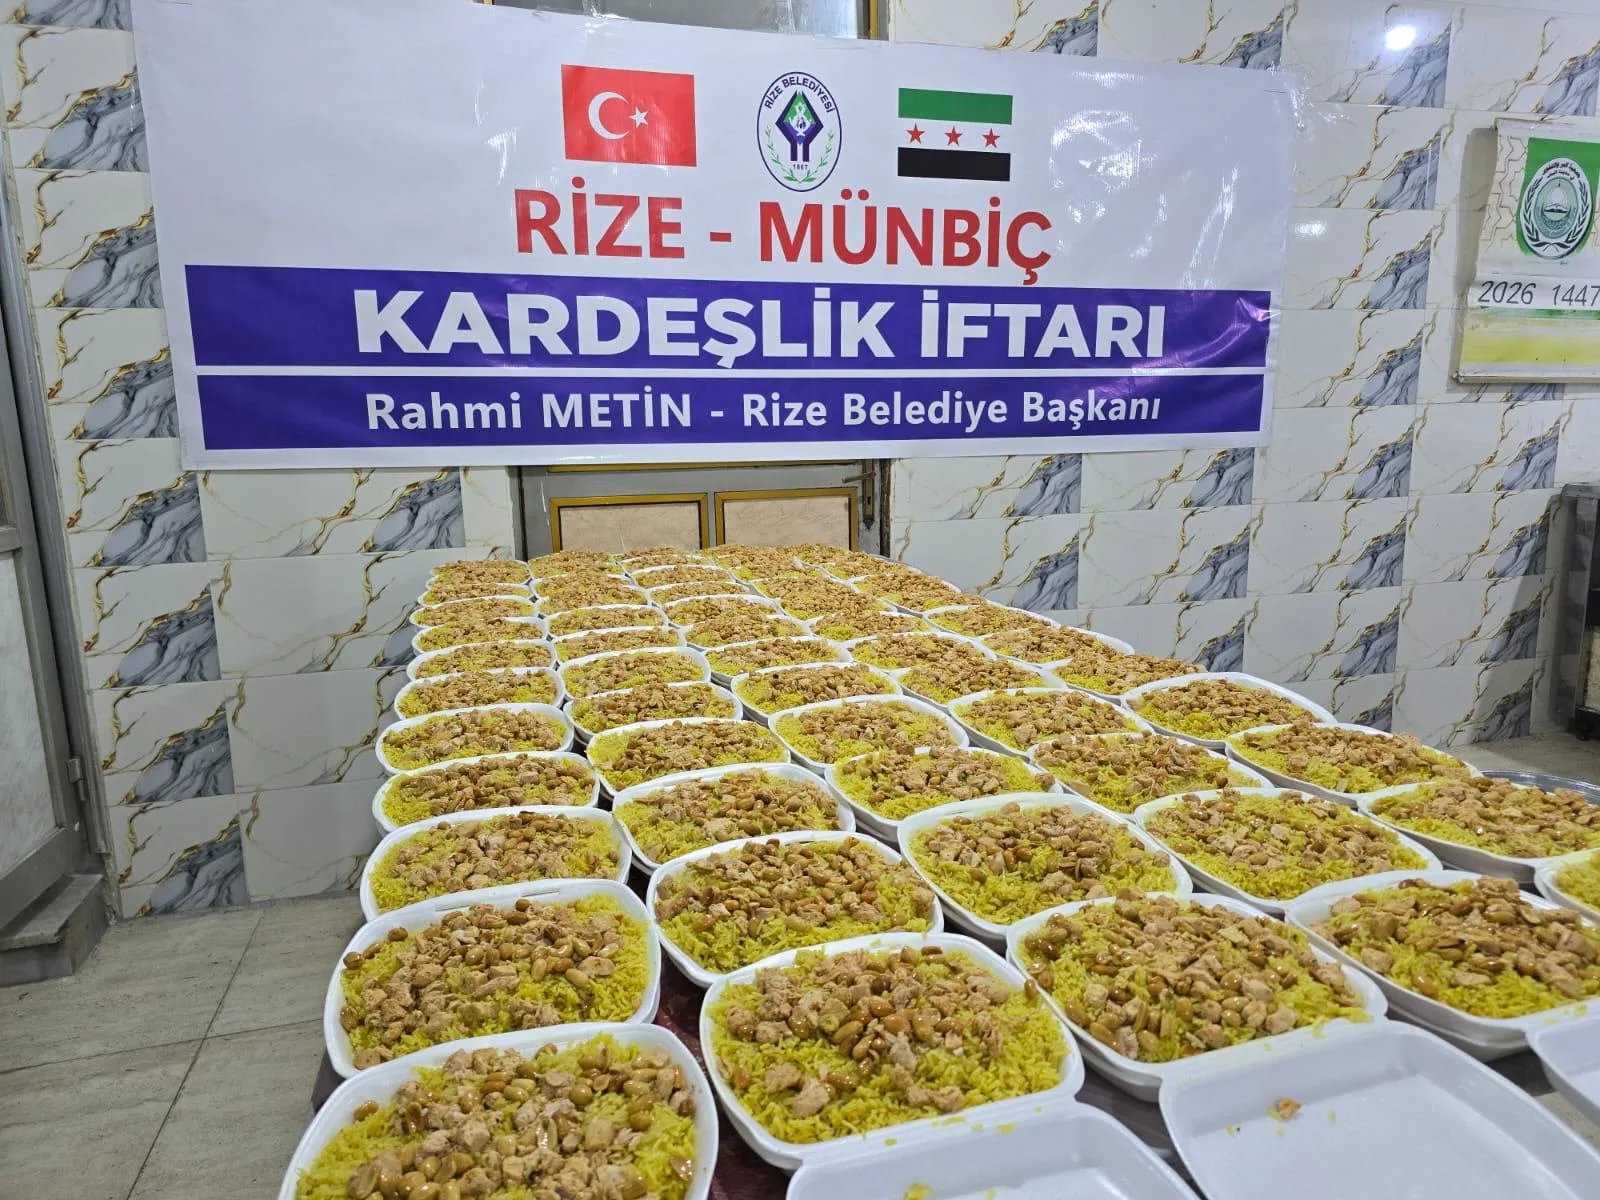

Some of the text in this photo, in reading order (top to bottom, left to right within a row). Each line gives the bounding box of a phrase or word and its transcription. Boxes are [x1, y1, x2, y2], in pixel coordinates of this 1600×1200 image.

[764, 76, 835, 113] RİZE BELEDİYESİ
[514, 176, 685, 259] RİZE
[759, 188, 1053, 285] MÜNBİÇ
[1478, 280, 1600, 307] 2026 1447
[353, 287, 1166, 369] KARDEŞLİK İFTARI
[366, 391, 522, 430] Rahmi
[542, 385, 691, 428] METİN
[743, 391, 827, 427] Rize
[843, 391, 1008, 433] Belediye
[1023, 389, 1161, 430] Başkanı
